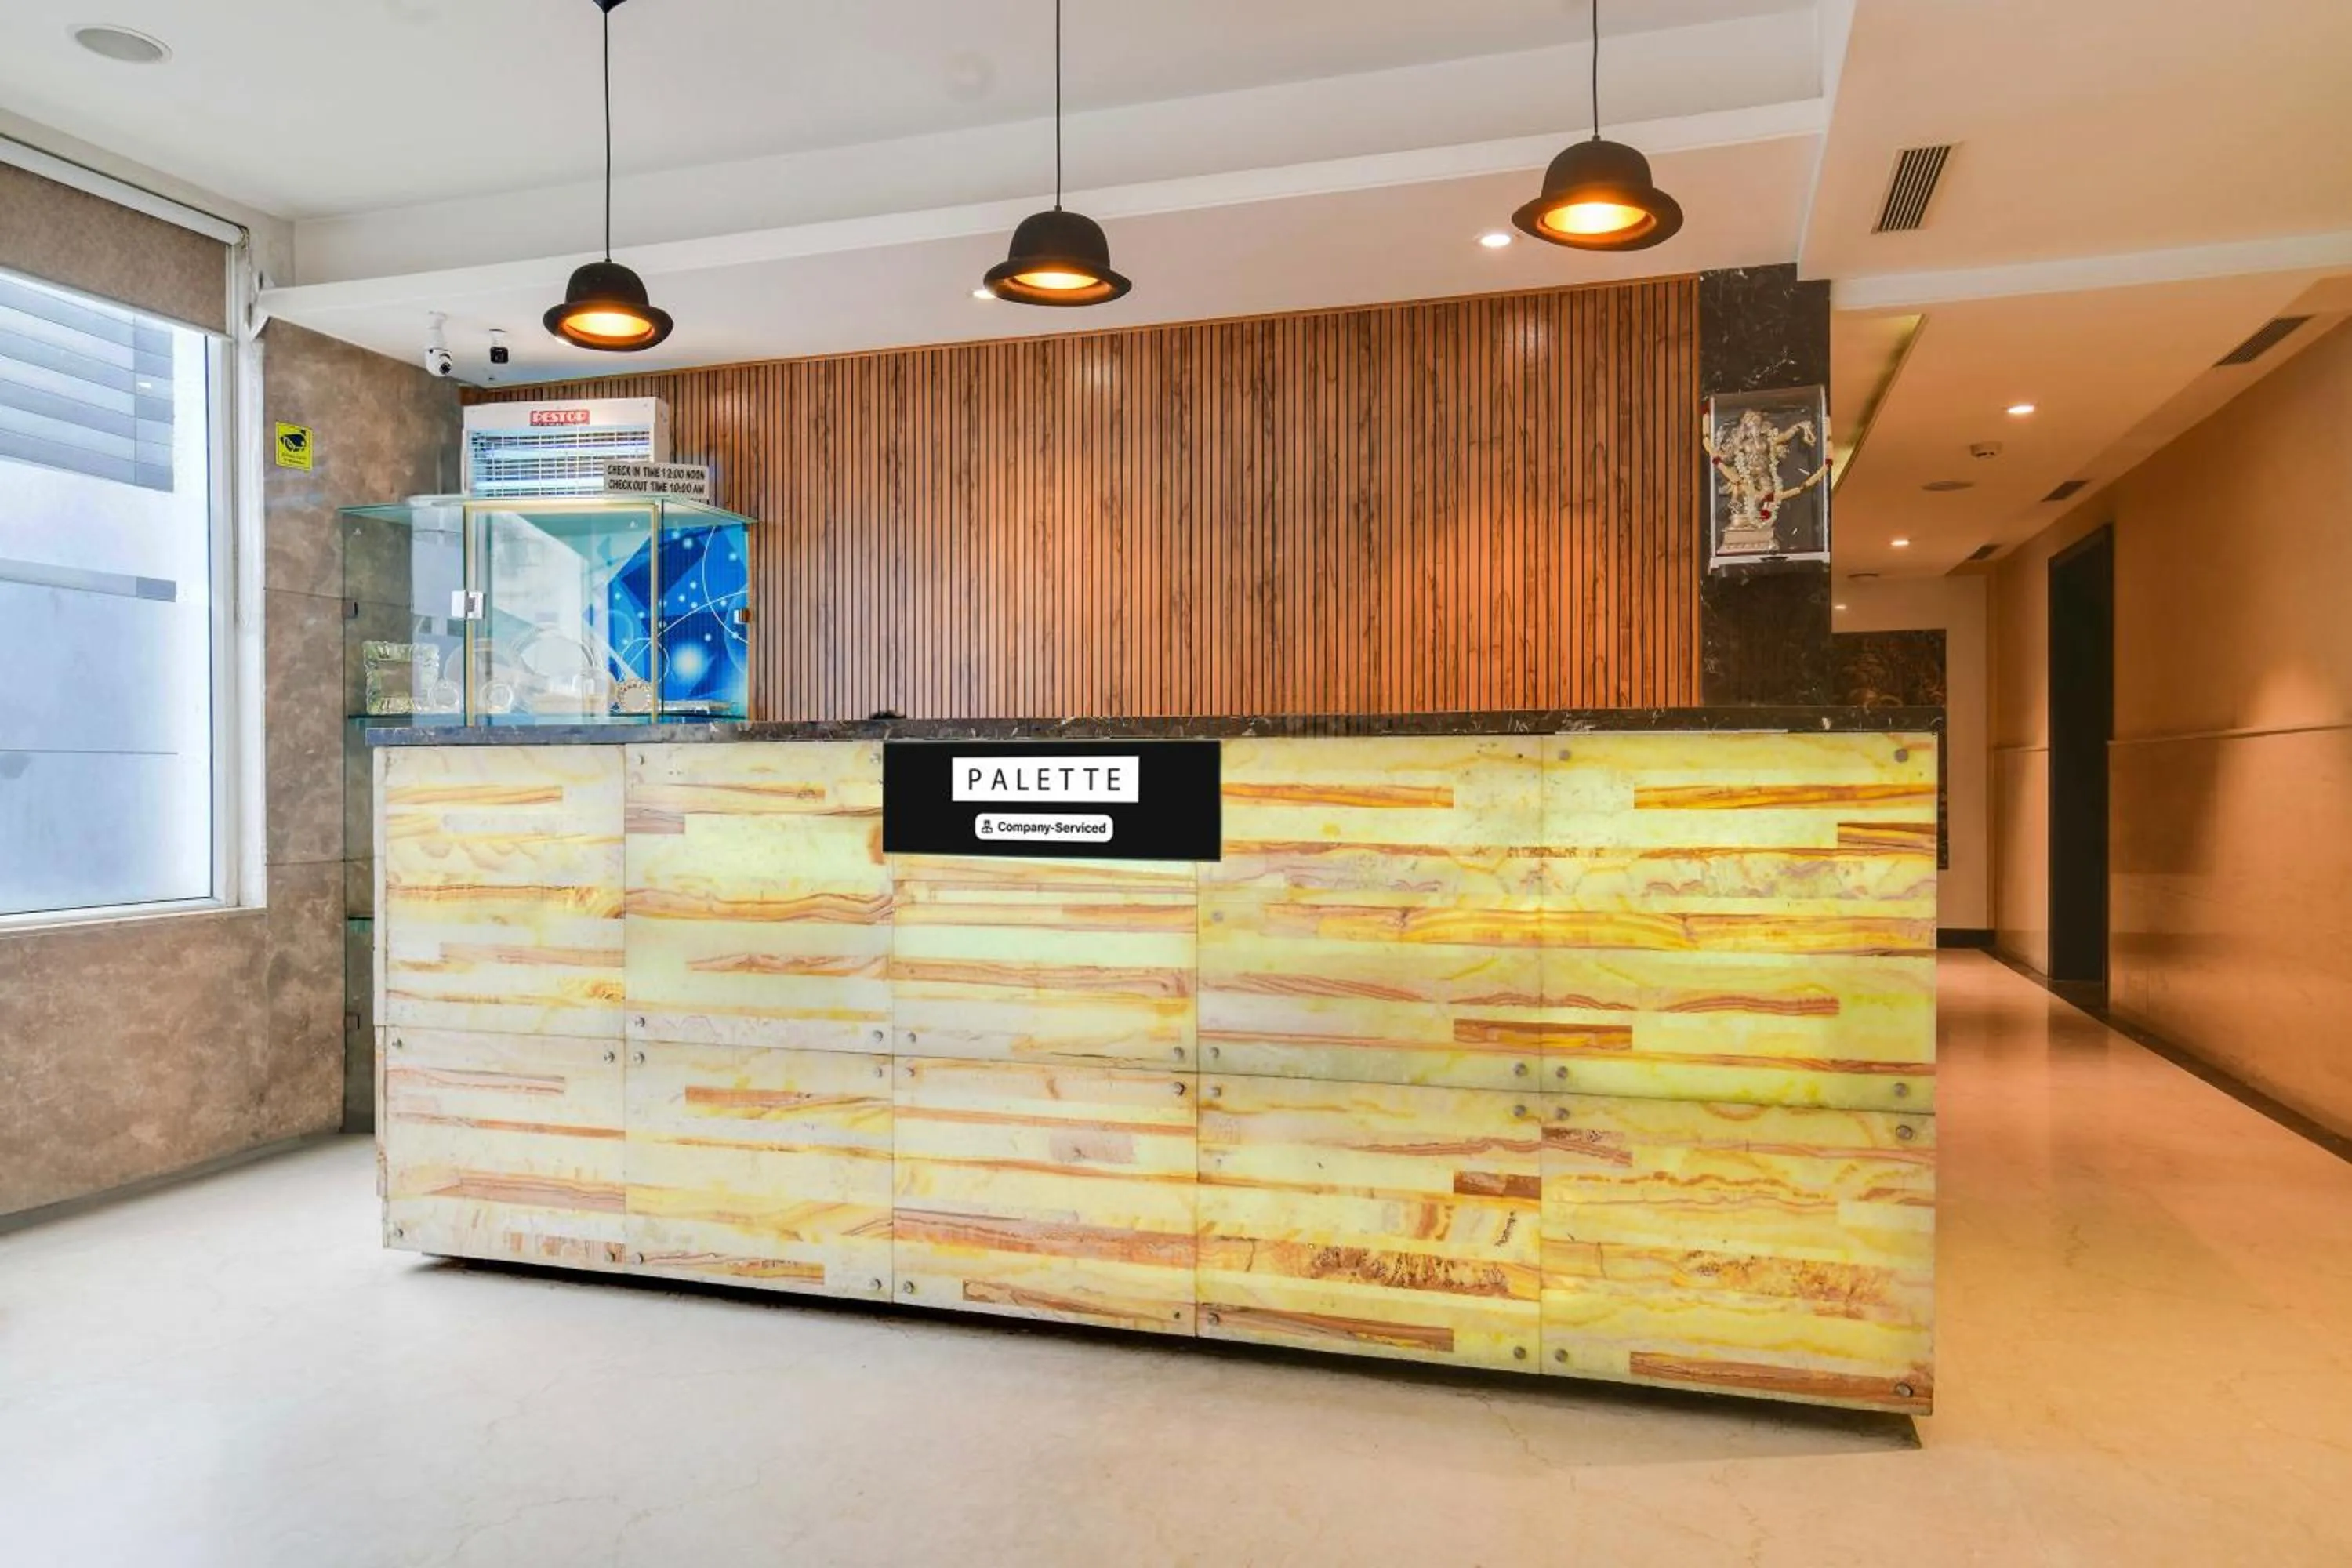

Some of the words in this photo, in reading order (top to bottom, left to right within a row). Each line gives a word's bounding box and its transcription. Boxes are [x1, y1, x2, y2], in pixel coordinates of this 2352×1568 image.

[608, 465, 630, 476] CHECK
[632, 466, 641, 477] IN
[643, 466, 660, 477] TIME
[686, 470, 705, 480] NOON
[608, 479, 632, 490] CHECK
[633, 481, 648, 492] OUT
[650, 481, 667, 492] TIME
[693, 484, 705, 494] AM
[967, 768, 1121, 791] PALETTE
[997, 821, 1106, 835] Company-Serviced
